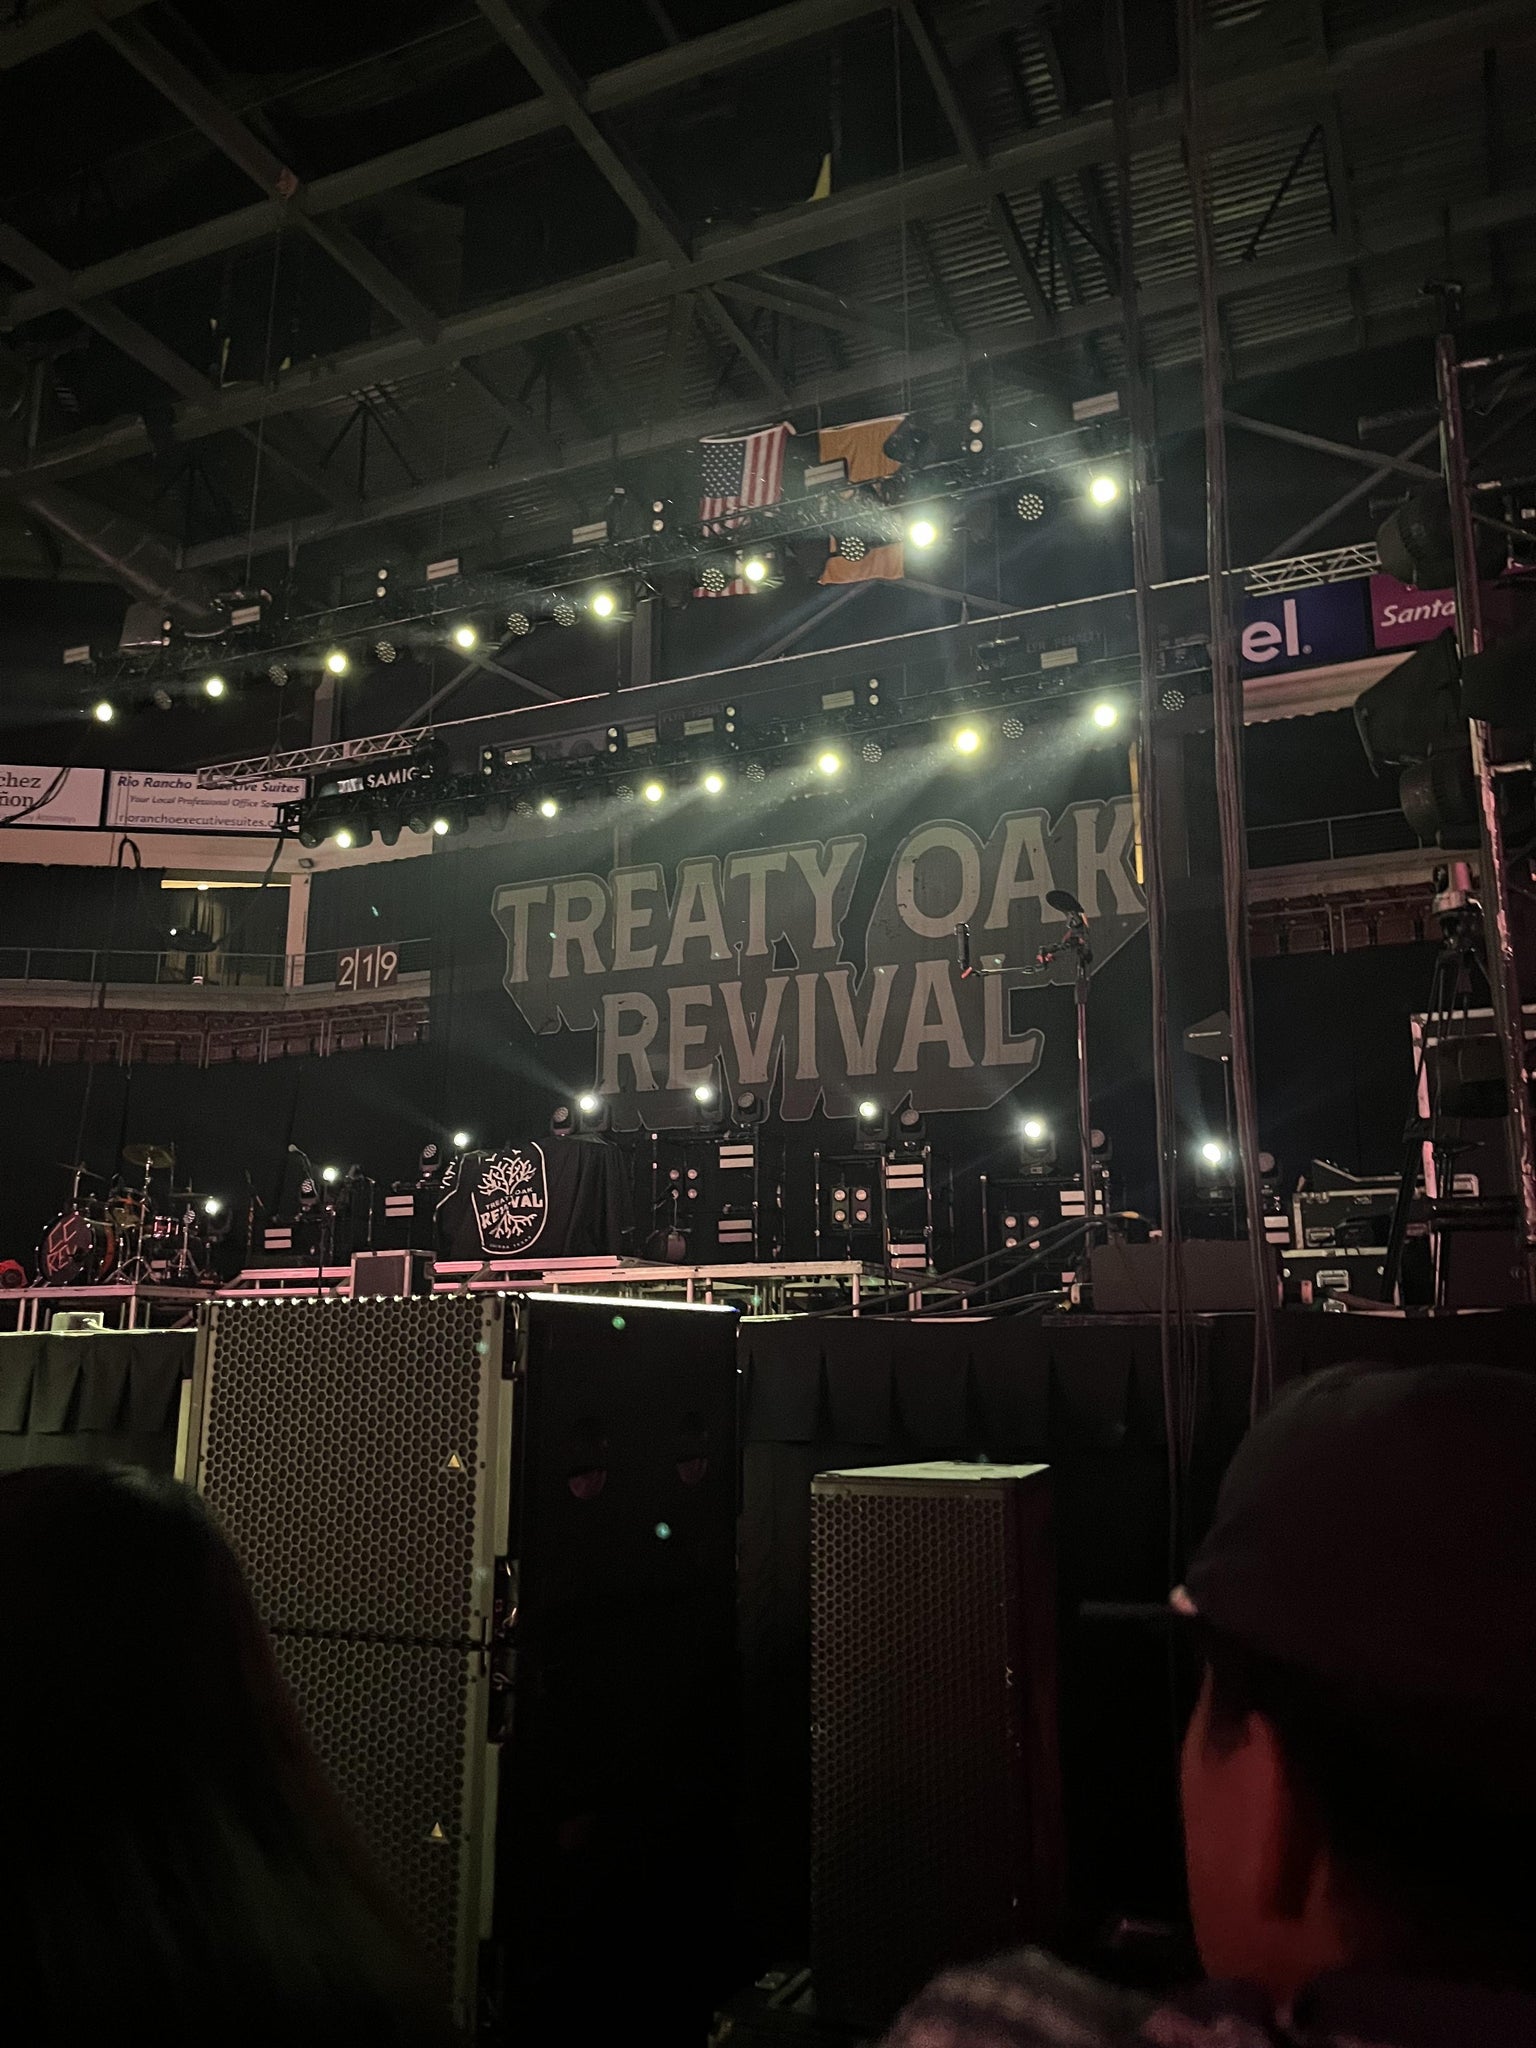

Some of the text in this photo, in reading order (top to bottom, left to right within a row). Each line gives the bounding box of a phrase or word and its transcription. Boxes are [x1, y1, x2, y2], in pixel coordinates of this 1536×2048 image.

[1381, 599, 1456, 627] Santa
[117, 776, 139, 787] Rio
[143, 777, 193, 789] Rancho
[261, 781, 300, 793] Suites
[119, 813, 280, 827] roranchoexecutivesuites.c
[496, 803, 1148, 985] TREATY OAK
[599, 954, 1039, 1095] REVIVAL
[485, 1187, 533, 1210] TREAT OAK
